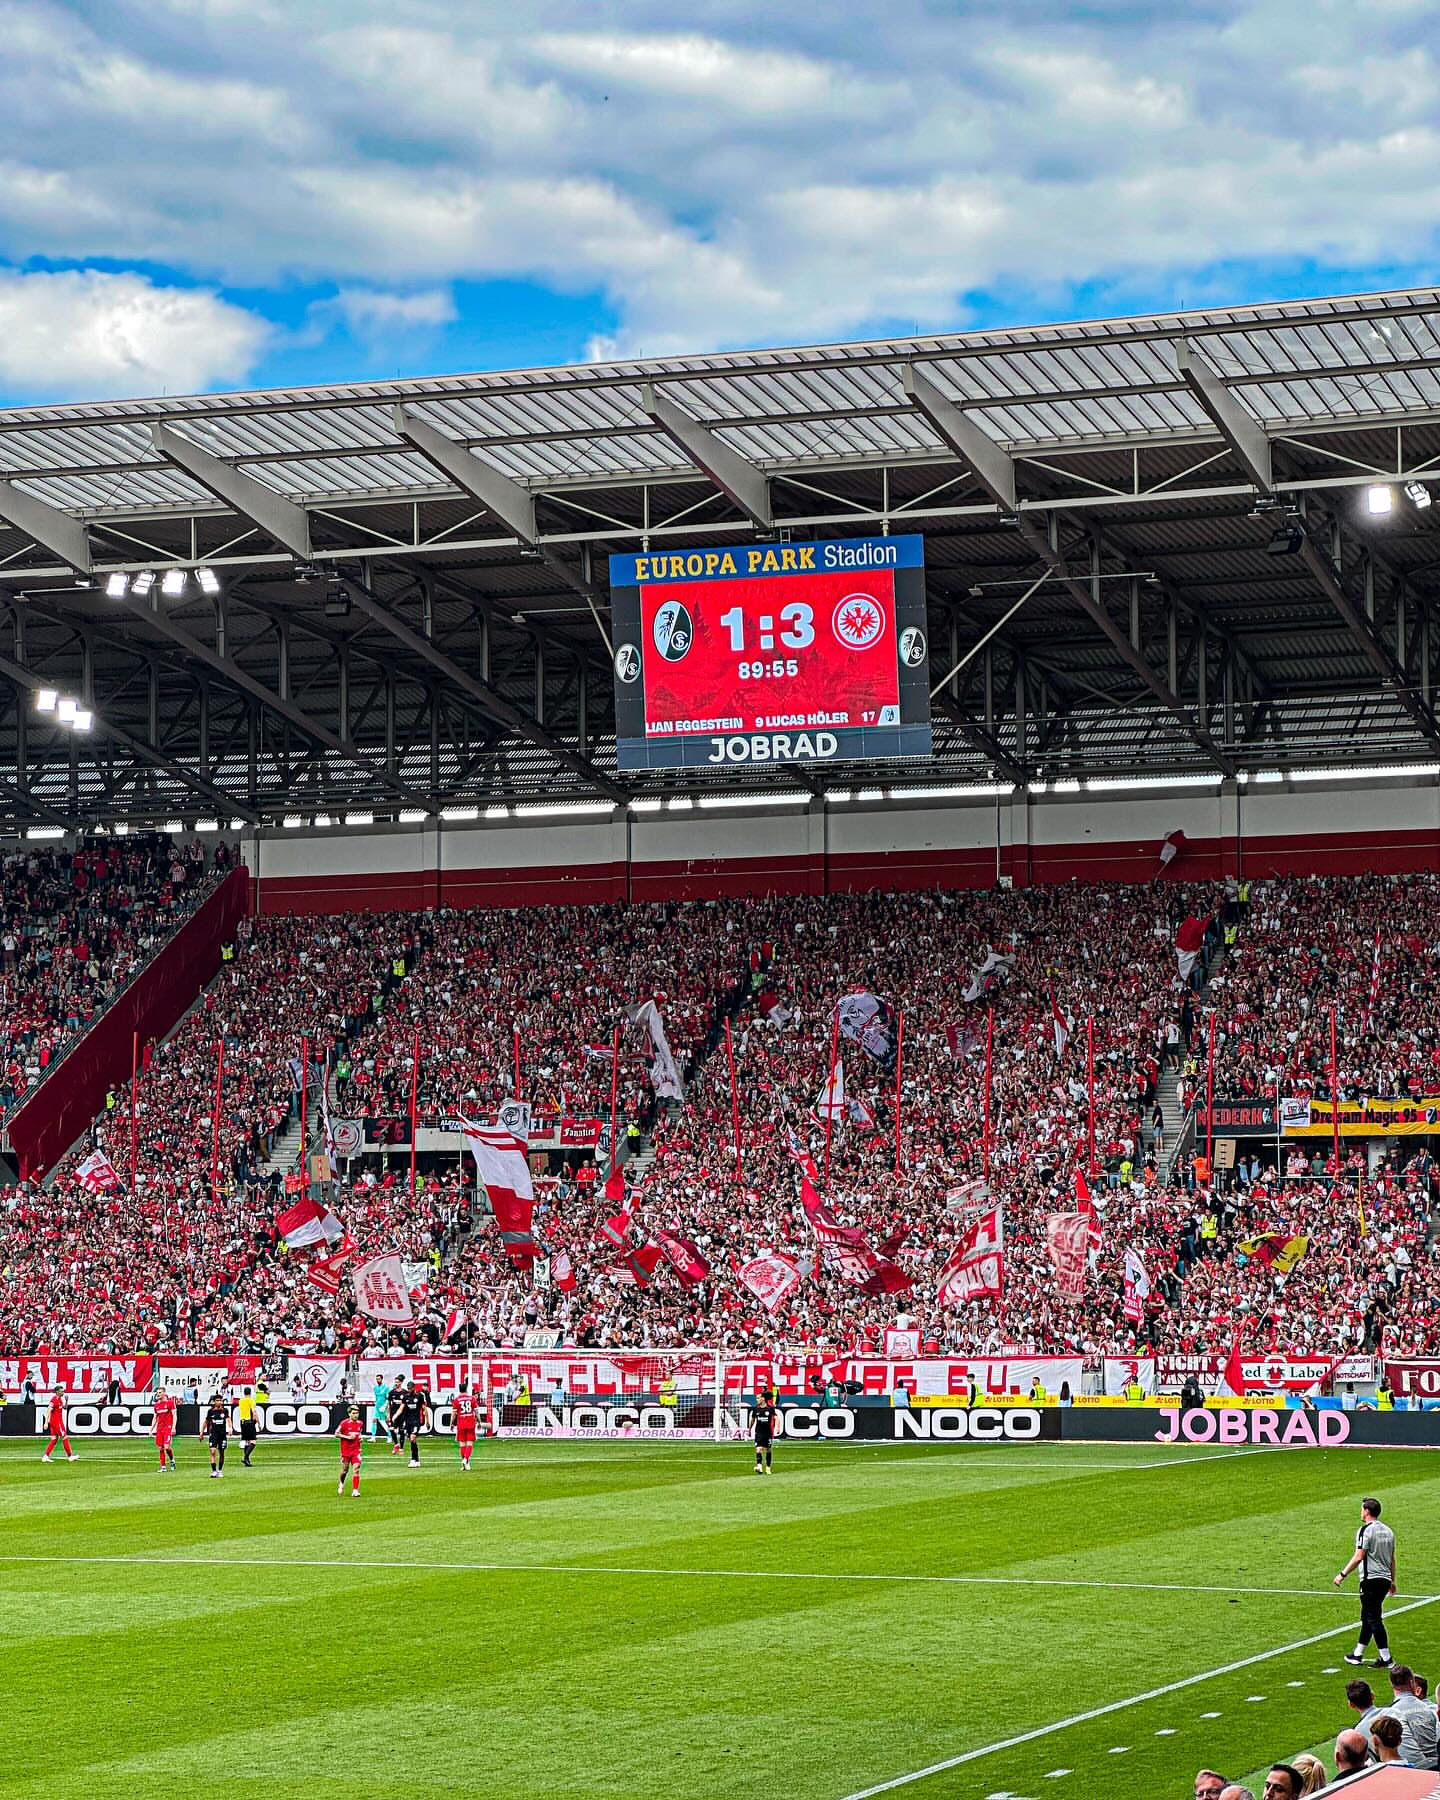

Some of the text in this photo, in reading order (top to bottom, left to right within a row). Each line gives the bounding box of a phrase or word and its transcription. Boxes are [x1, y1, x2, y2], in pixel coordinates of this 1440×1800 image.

[635, 543, 897, 580] EUROPA PARK Stadion
[720, 602, 815, 651] 1:3
[738, 659, 798, 679] 89:55
[675, 718, 743, 732] EGGESTEIN
[756, 716, 764, 727] 9
[766, 714, 805, 727] LUCAS
[807, 711, 849, 724] HÖLER
[861, 711, 875, 722] 17
[708, 732, 838, 763] JOBRAD
[1311, 1108, 1360, 1123] Dresam
[1365, 1107, 1399, 1127] Magic
[1403, 1108, 1417, 1123] 95
[165, 1375, 202, 1386] Fanclb
[460, 1401, 472, 1413] 38
[993, 1396, 1015, 1404] LOTTO
[1252, 1397, 1275, 1405] LOTTO
[505, 1427, 553, 1437] JOBRAD
[569, 1428, 618, 1438] JOBRAD
[634, 1428, 684, 1438] JOBRAD
[894, 1408, 1041, 1438] NOCO
[1154, 1408, 1350, 1445] JOBRAD
